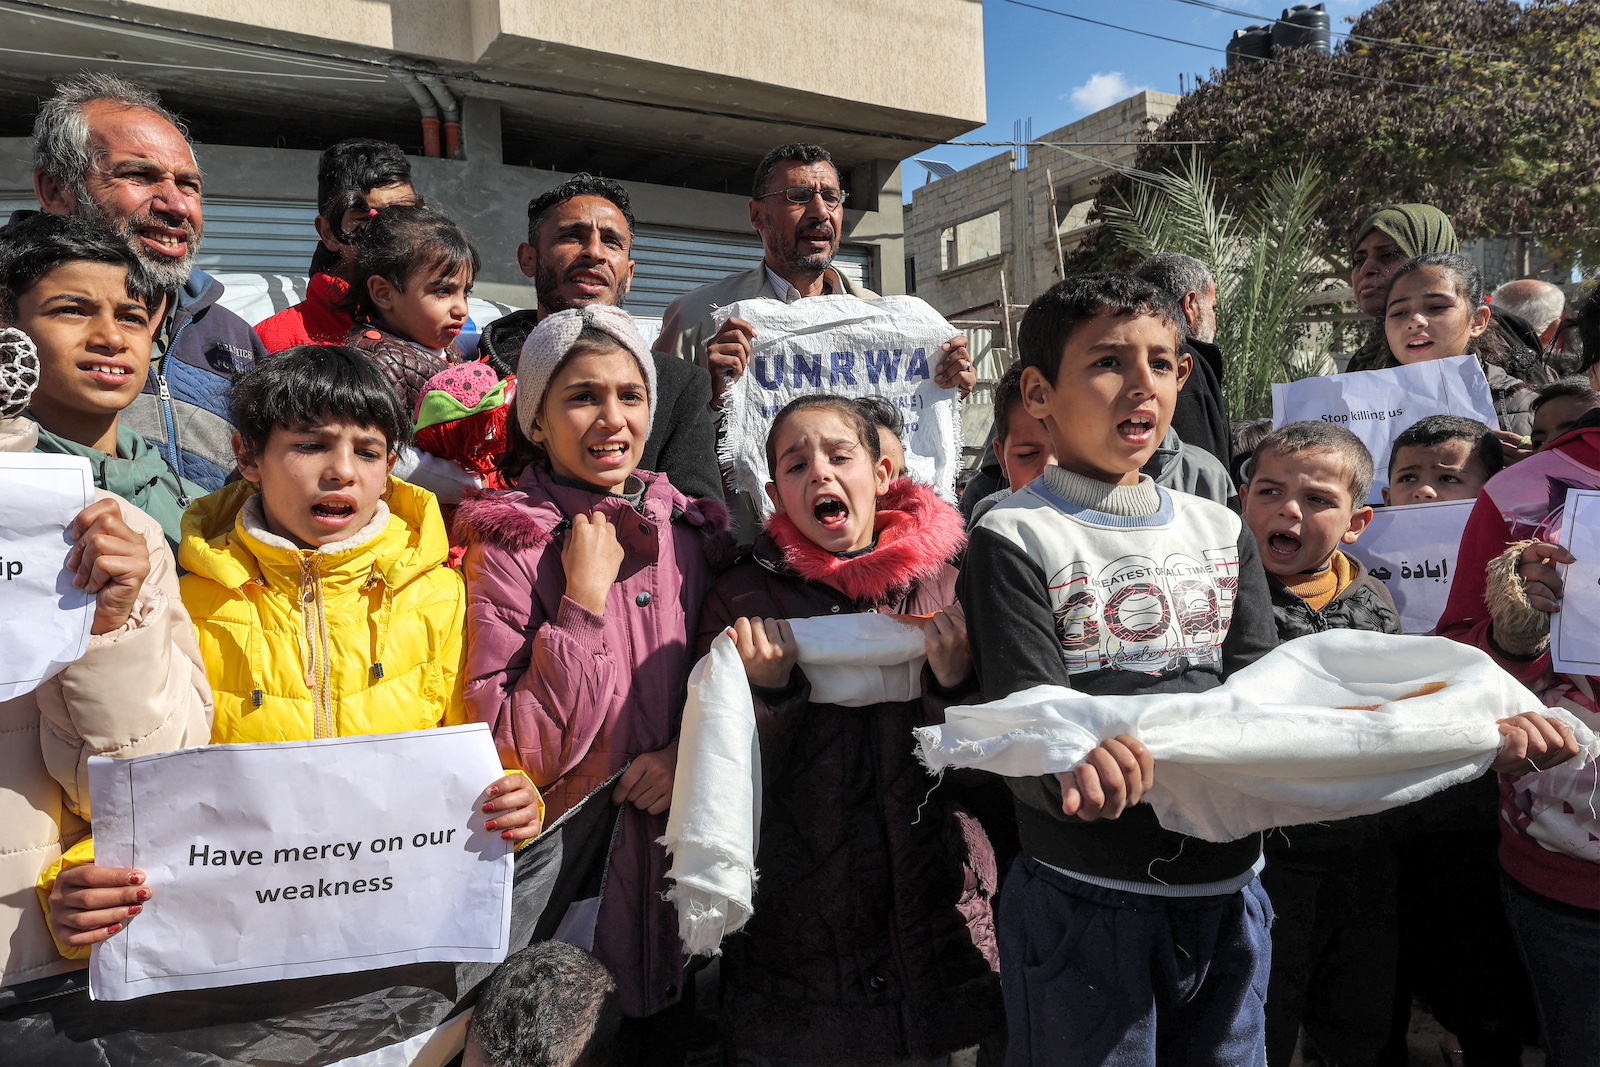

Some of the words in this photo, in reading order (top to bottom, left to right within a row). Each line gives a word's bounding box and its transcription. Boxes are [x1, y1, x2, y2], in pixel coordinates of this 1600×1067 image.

[755, 348, 930, 391] UNRWA
[1321, 414, 1348, 424] Stop
[1350, 410, 1386, 421] killing
[1389, 408, 1403, 418] us
[1166, 566, 1185, 577] ALL
[1186, 564, 1213, 576] TIME
[1401, 558, 1447, 584] إبادة
[189, 844, 263, 866] Have
[273, 840, 362, 862] mercy
[370, 837, 403, 852] on
[412, 828, 456, 847] our
[255, 876, 393, 904] weakness
